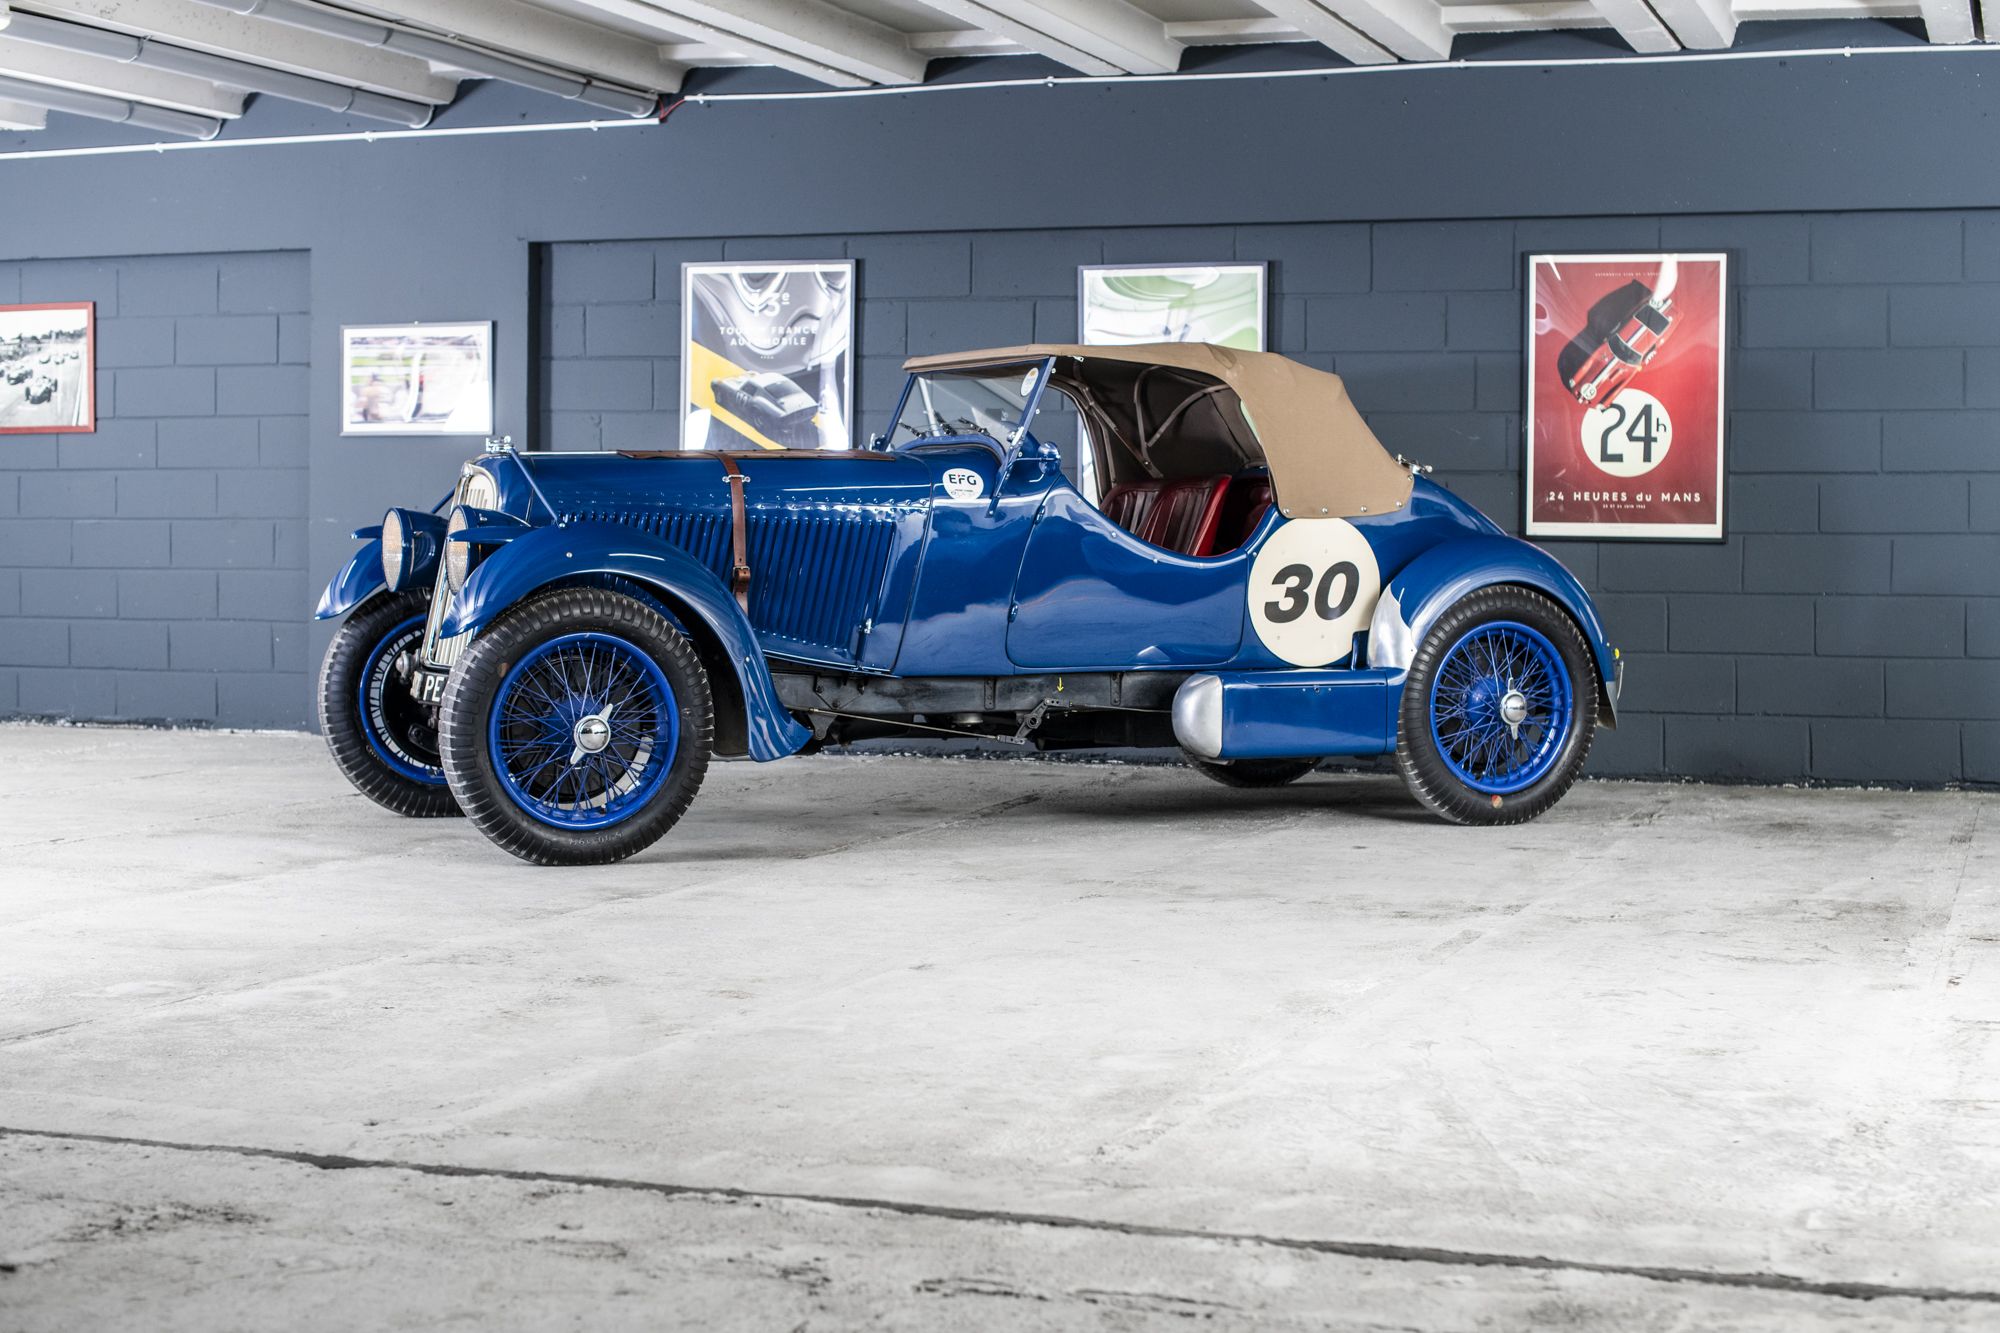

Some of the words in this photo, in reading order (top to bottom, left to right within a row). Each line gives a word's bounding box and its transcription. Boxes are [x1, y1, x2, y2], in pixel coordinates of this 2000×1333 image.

[730, 337, 807, 346] AUOBILE
[948, 474, 977, 486] EFG
[1549, 491, 1565, 501] 24
[1573, 491, 1628, 502] HEURES
[1636, 491, 1652, 502] du
[1661, 492, 1701, 502] MANS
[1264, 560, 1360, 624] 30
